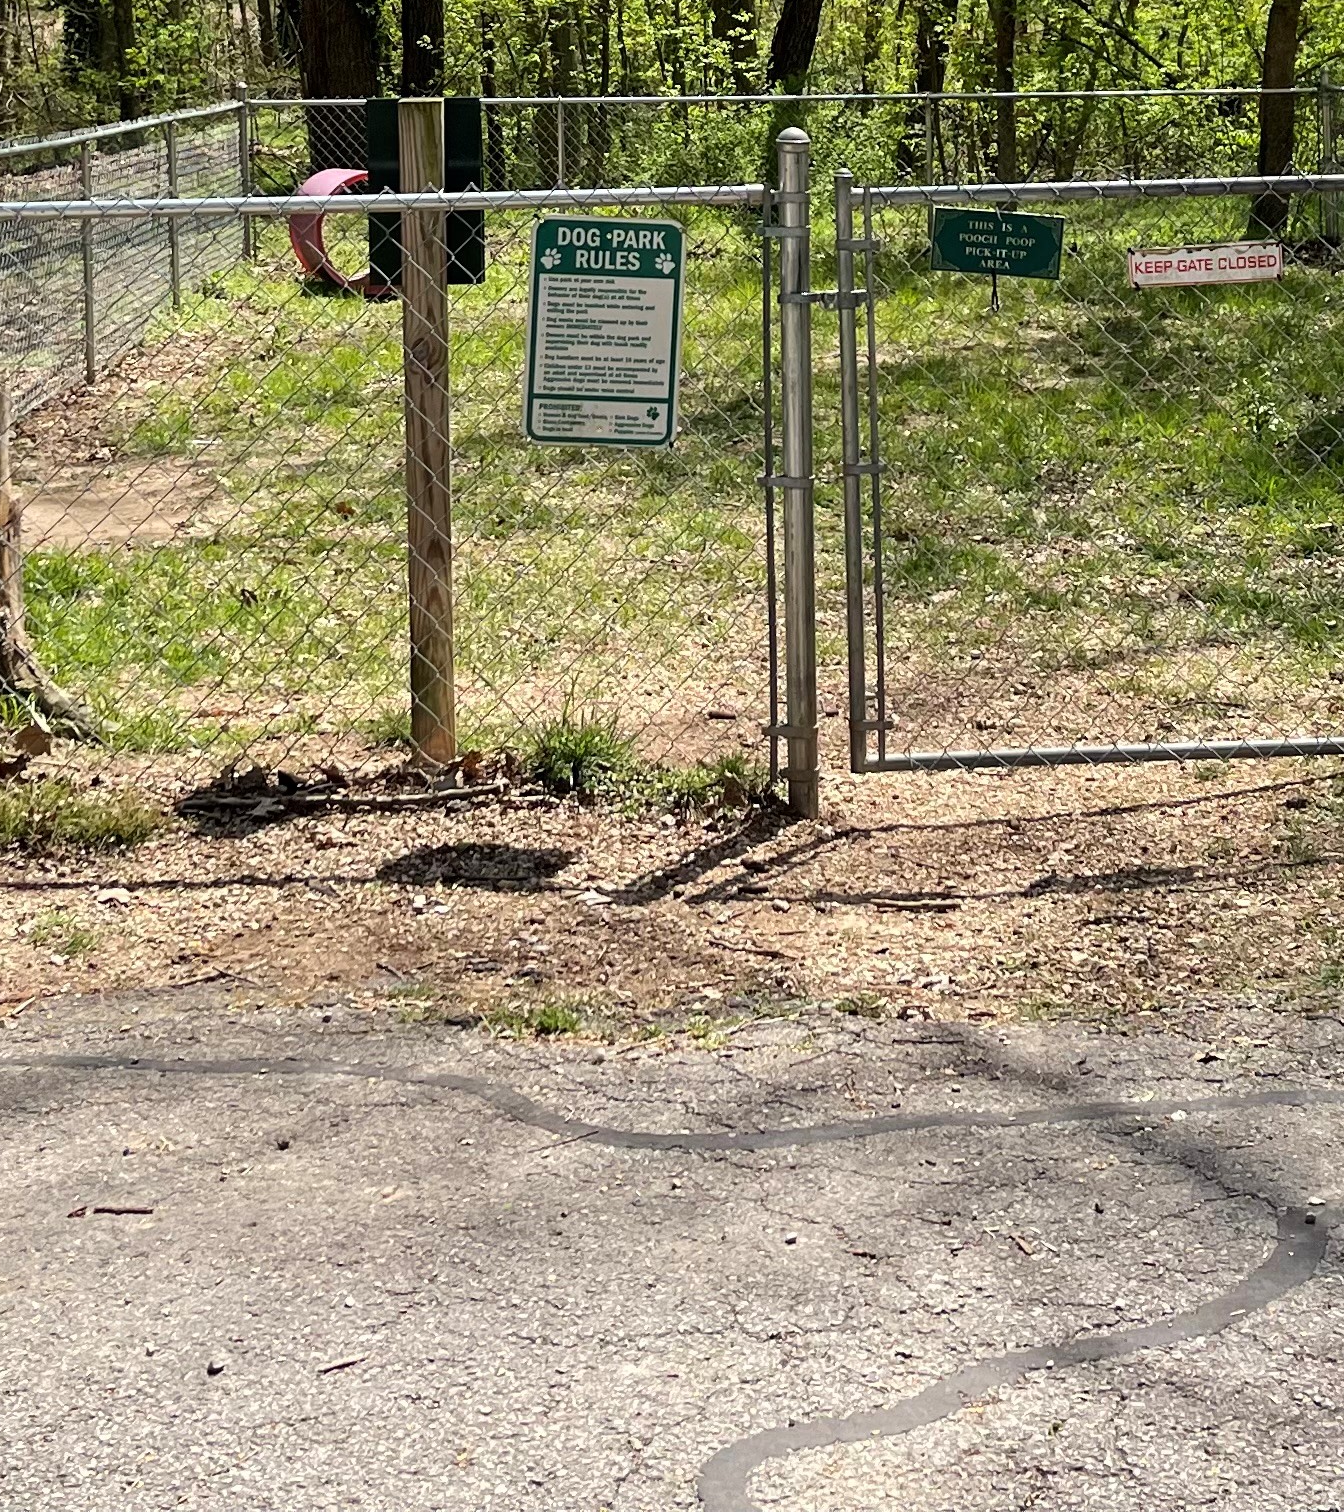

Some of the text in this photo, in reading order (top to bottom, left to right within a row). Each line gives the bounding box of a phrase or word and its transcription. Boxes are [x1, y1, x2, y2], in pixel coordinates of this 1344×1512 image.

[968, 221, 1027, 233] THIS IS A
[558, 227, 665, 249] DOG PARK
[959, 234, 1035, 247] POOCH POOP
[576, 250, 640, 270] RULES
[966, 247, 1027, 260] PICK-IT-UP
[979, 260, 1010, 269] AREA
[1135, 255, 1276, 274] KEEP GATE CLOSED
